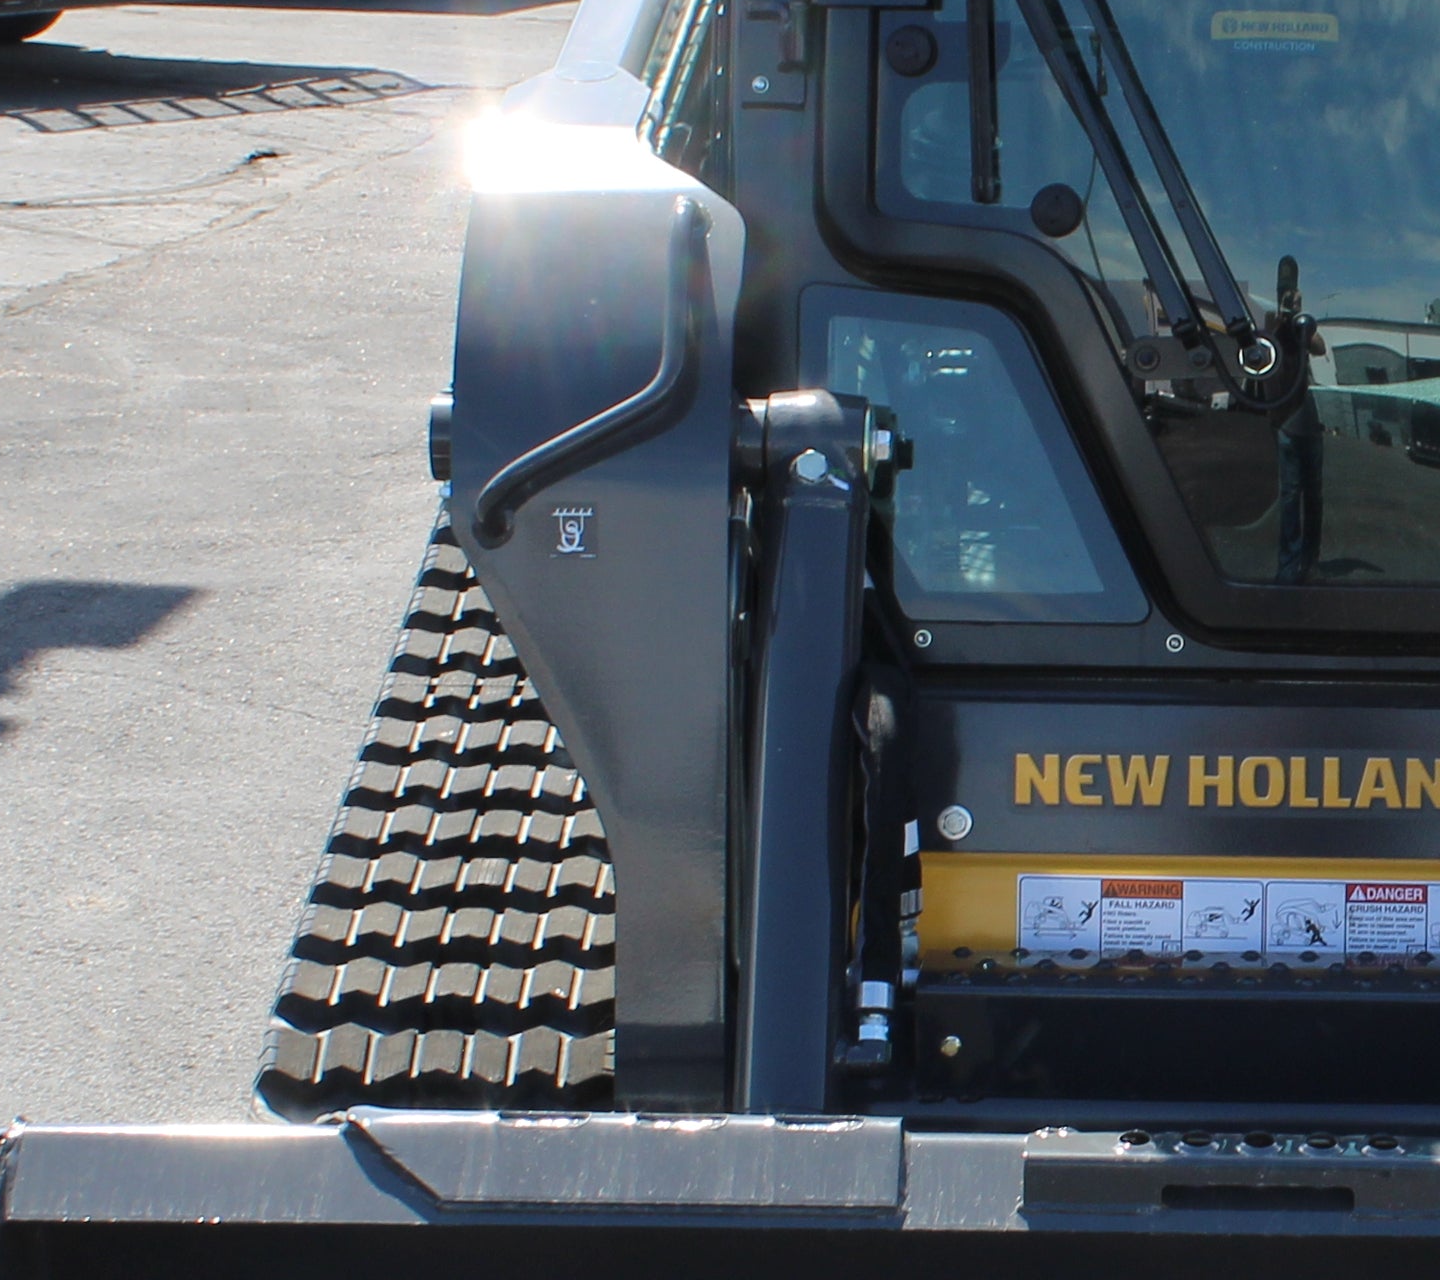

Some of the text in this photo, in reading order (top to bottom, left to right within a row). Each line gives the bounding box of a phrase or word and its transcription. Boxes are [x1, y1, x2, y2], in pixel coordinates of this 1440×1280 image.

[1015, 753, 1170, 806] NEW
[1117, 883, 1180, 896] WARNING
[1366, 887, 1424, 901] DANGER
[1109, 900, 1176, 910] FALL HAZARD
[1349, 904, 1424, 913] CRUSH HAZARD
